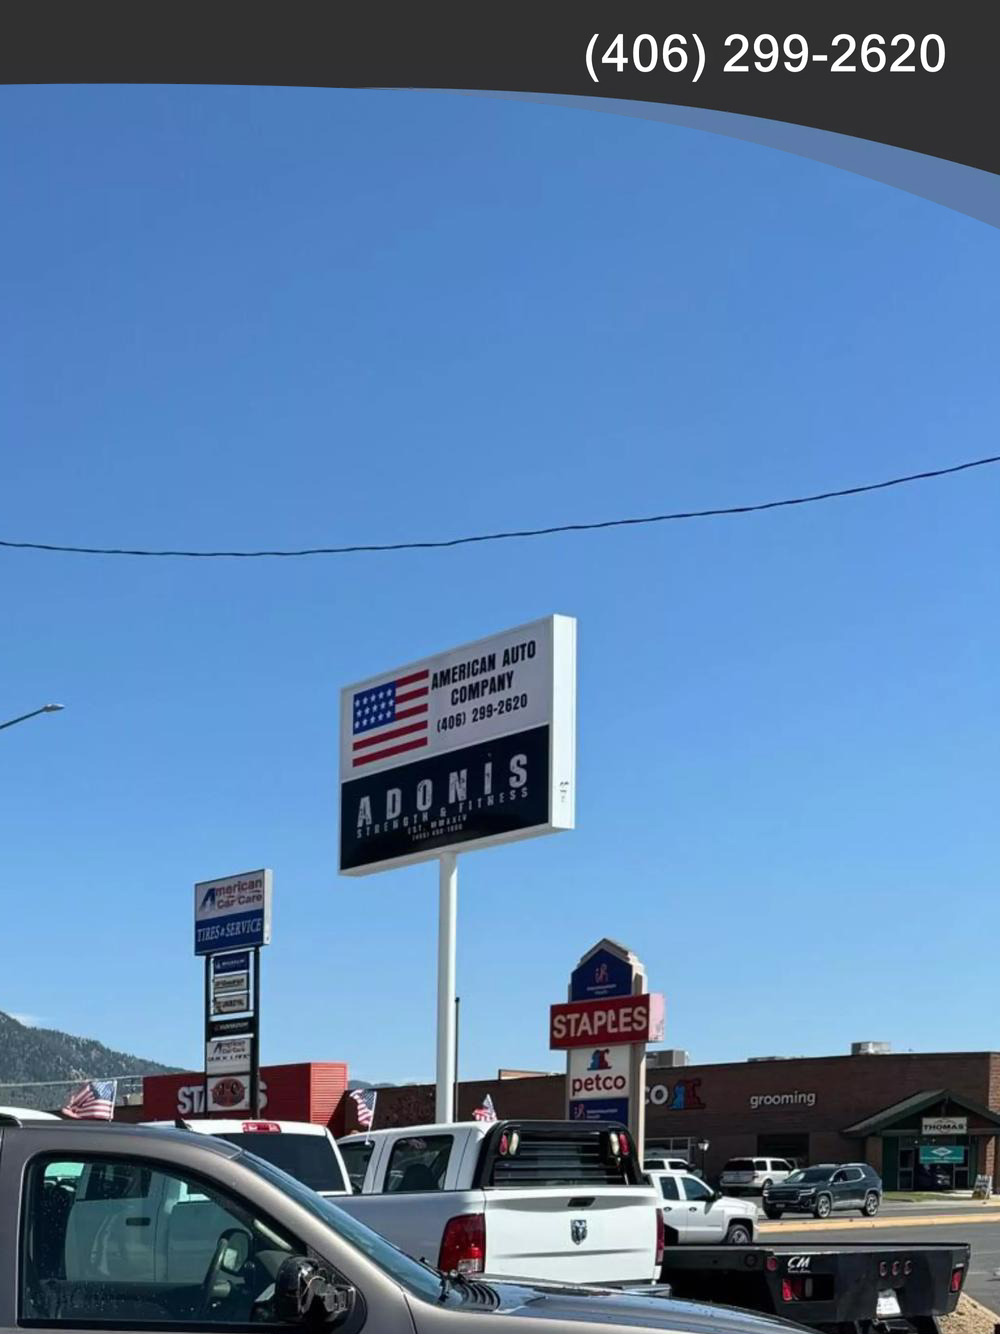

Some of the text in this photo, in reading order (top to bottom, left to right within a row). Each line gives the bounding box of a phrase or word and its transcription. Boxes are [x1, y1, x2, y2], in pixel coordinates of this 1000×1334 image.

[431, 640, 536, 690] AMERICAN AUTO
[450, 670, 514, 706] COMPANY
[436, 693, 528, 733] (406) 299-2620
[357, 812, 429, 839] STRENGTH
[440, 807, 447, 818] &
[459, 787, 528, 813] FITNESS
[199, 879, 262, 912] American
[217, 893, 262, 910] Car Care
[197, 924, 220, 942] TIRES
[225, 918, 262, 937] SERVICE
[552, 1006, 648, 1039] STAPLES
[572, 1074, 626, 1096] petco
[750, 1091, 816, 1109] grooming
[787, 1256, 811, 1268] CM
